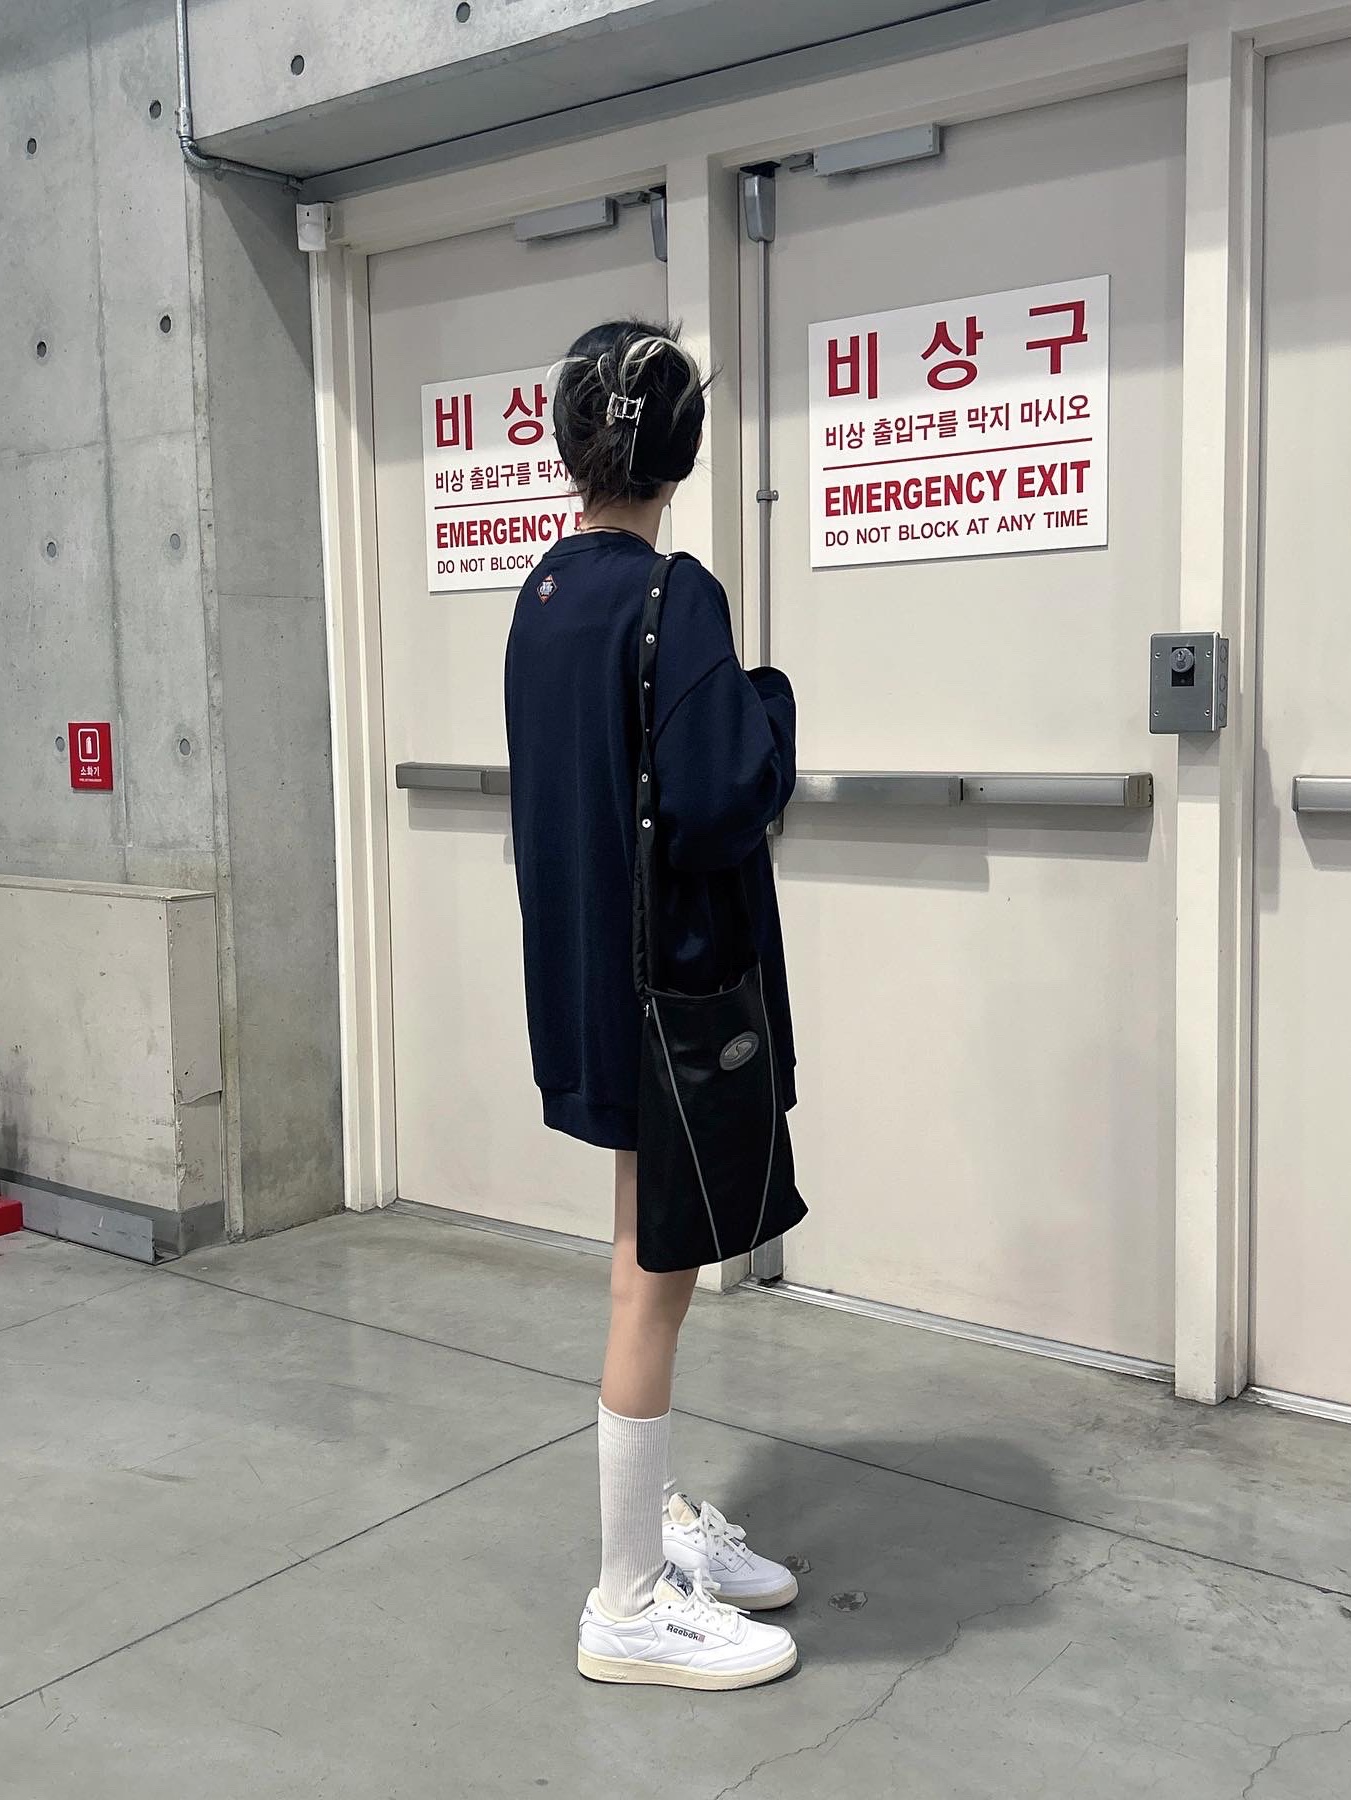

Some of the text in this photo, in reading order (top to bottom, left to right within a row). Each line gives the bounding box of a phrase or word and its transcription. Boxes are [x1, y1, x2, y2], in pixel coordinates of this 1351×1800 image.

[825, 394, 1090, 450] 비상 출입구를 막지 마시오
[435, 469, 464, 493] 비상
[470, 462, 531, 490] 출입구를
[825, 460, 1091, 517] EMERGENCY EXIT
[436, 512, 567, 548] EMERGENCY
[825, 508, 1089, 547] DO NOT BLOCK AT ANY TIME
[437, 554, 534, 574] DO NOT BLOCK
[80, 765, 100, 777] 소화기
[666, 1623, 699, 1641] Reebok
